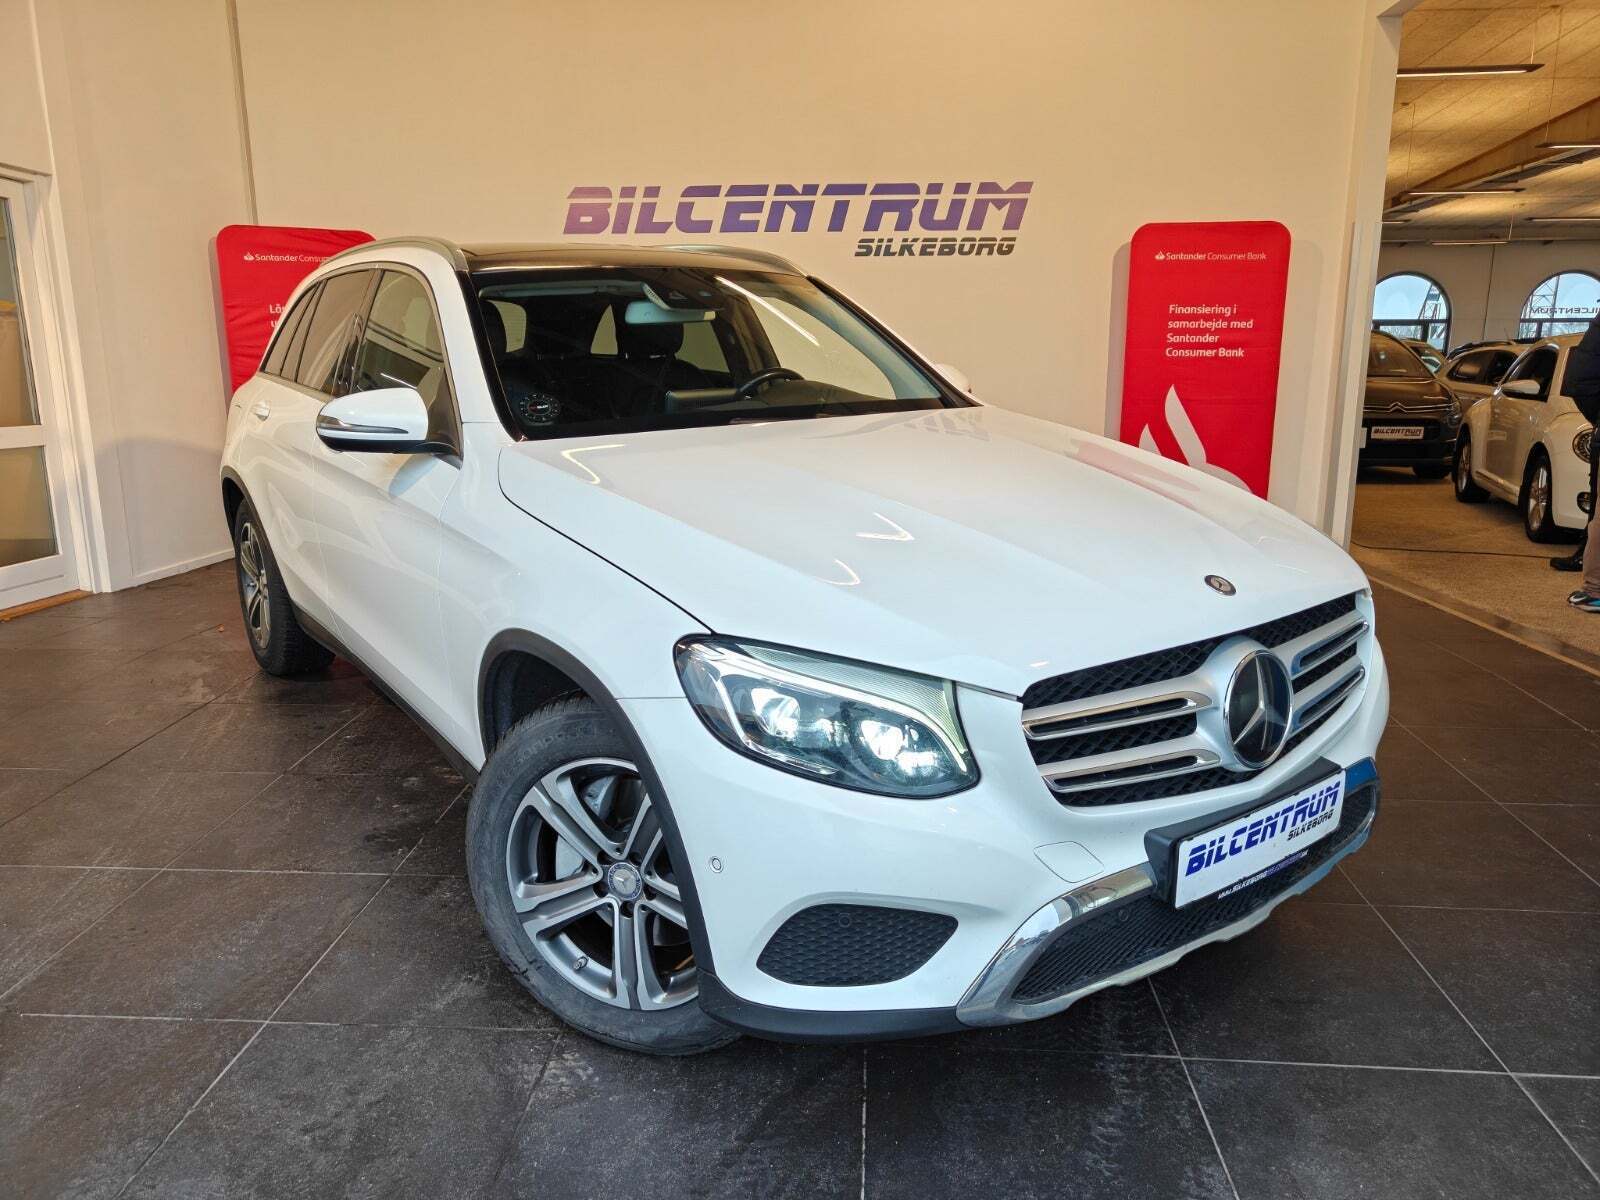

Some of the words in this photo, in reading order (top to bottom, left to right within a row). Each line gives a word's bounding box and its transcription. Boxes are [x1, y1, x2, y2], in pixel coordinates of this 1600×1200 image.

[563, 181, 1034, 235] BILCENTRUM
[854, 237, 1017, 257] SILKEBORG
[255, 254, 298, 262] Santander
[1166, 252, 1206, 261] Santander
[1207, 252, 1246, 261] Consumer
[1247, 252, 1267, 260] Bank
[1169, 304, 1231, 317] Finansiering
[1233, 304, 1237, 314] i
[1167, 319, 1228, 331] samarbejde
[1230, 319, 1253, 329] med
[1166, 333, 1219, 343] Santander
[1165, 348, 1217, 357] Consumer
[1218, 348, 1245, 357] Bank
[1185, 781, 1341, 877] BILCENTRUM
[1287, 808, 1335, 842] SILKEBORG
